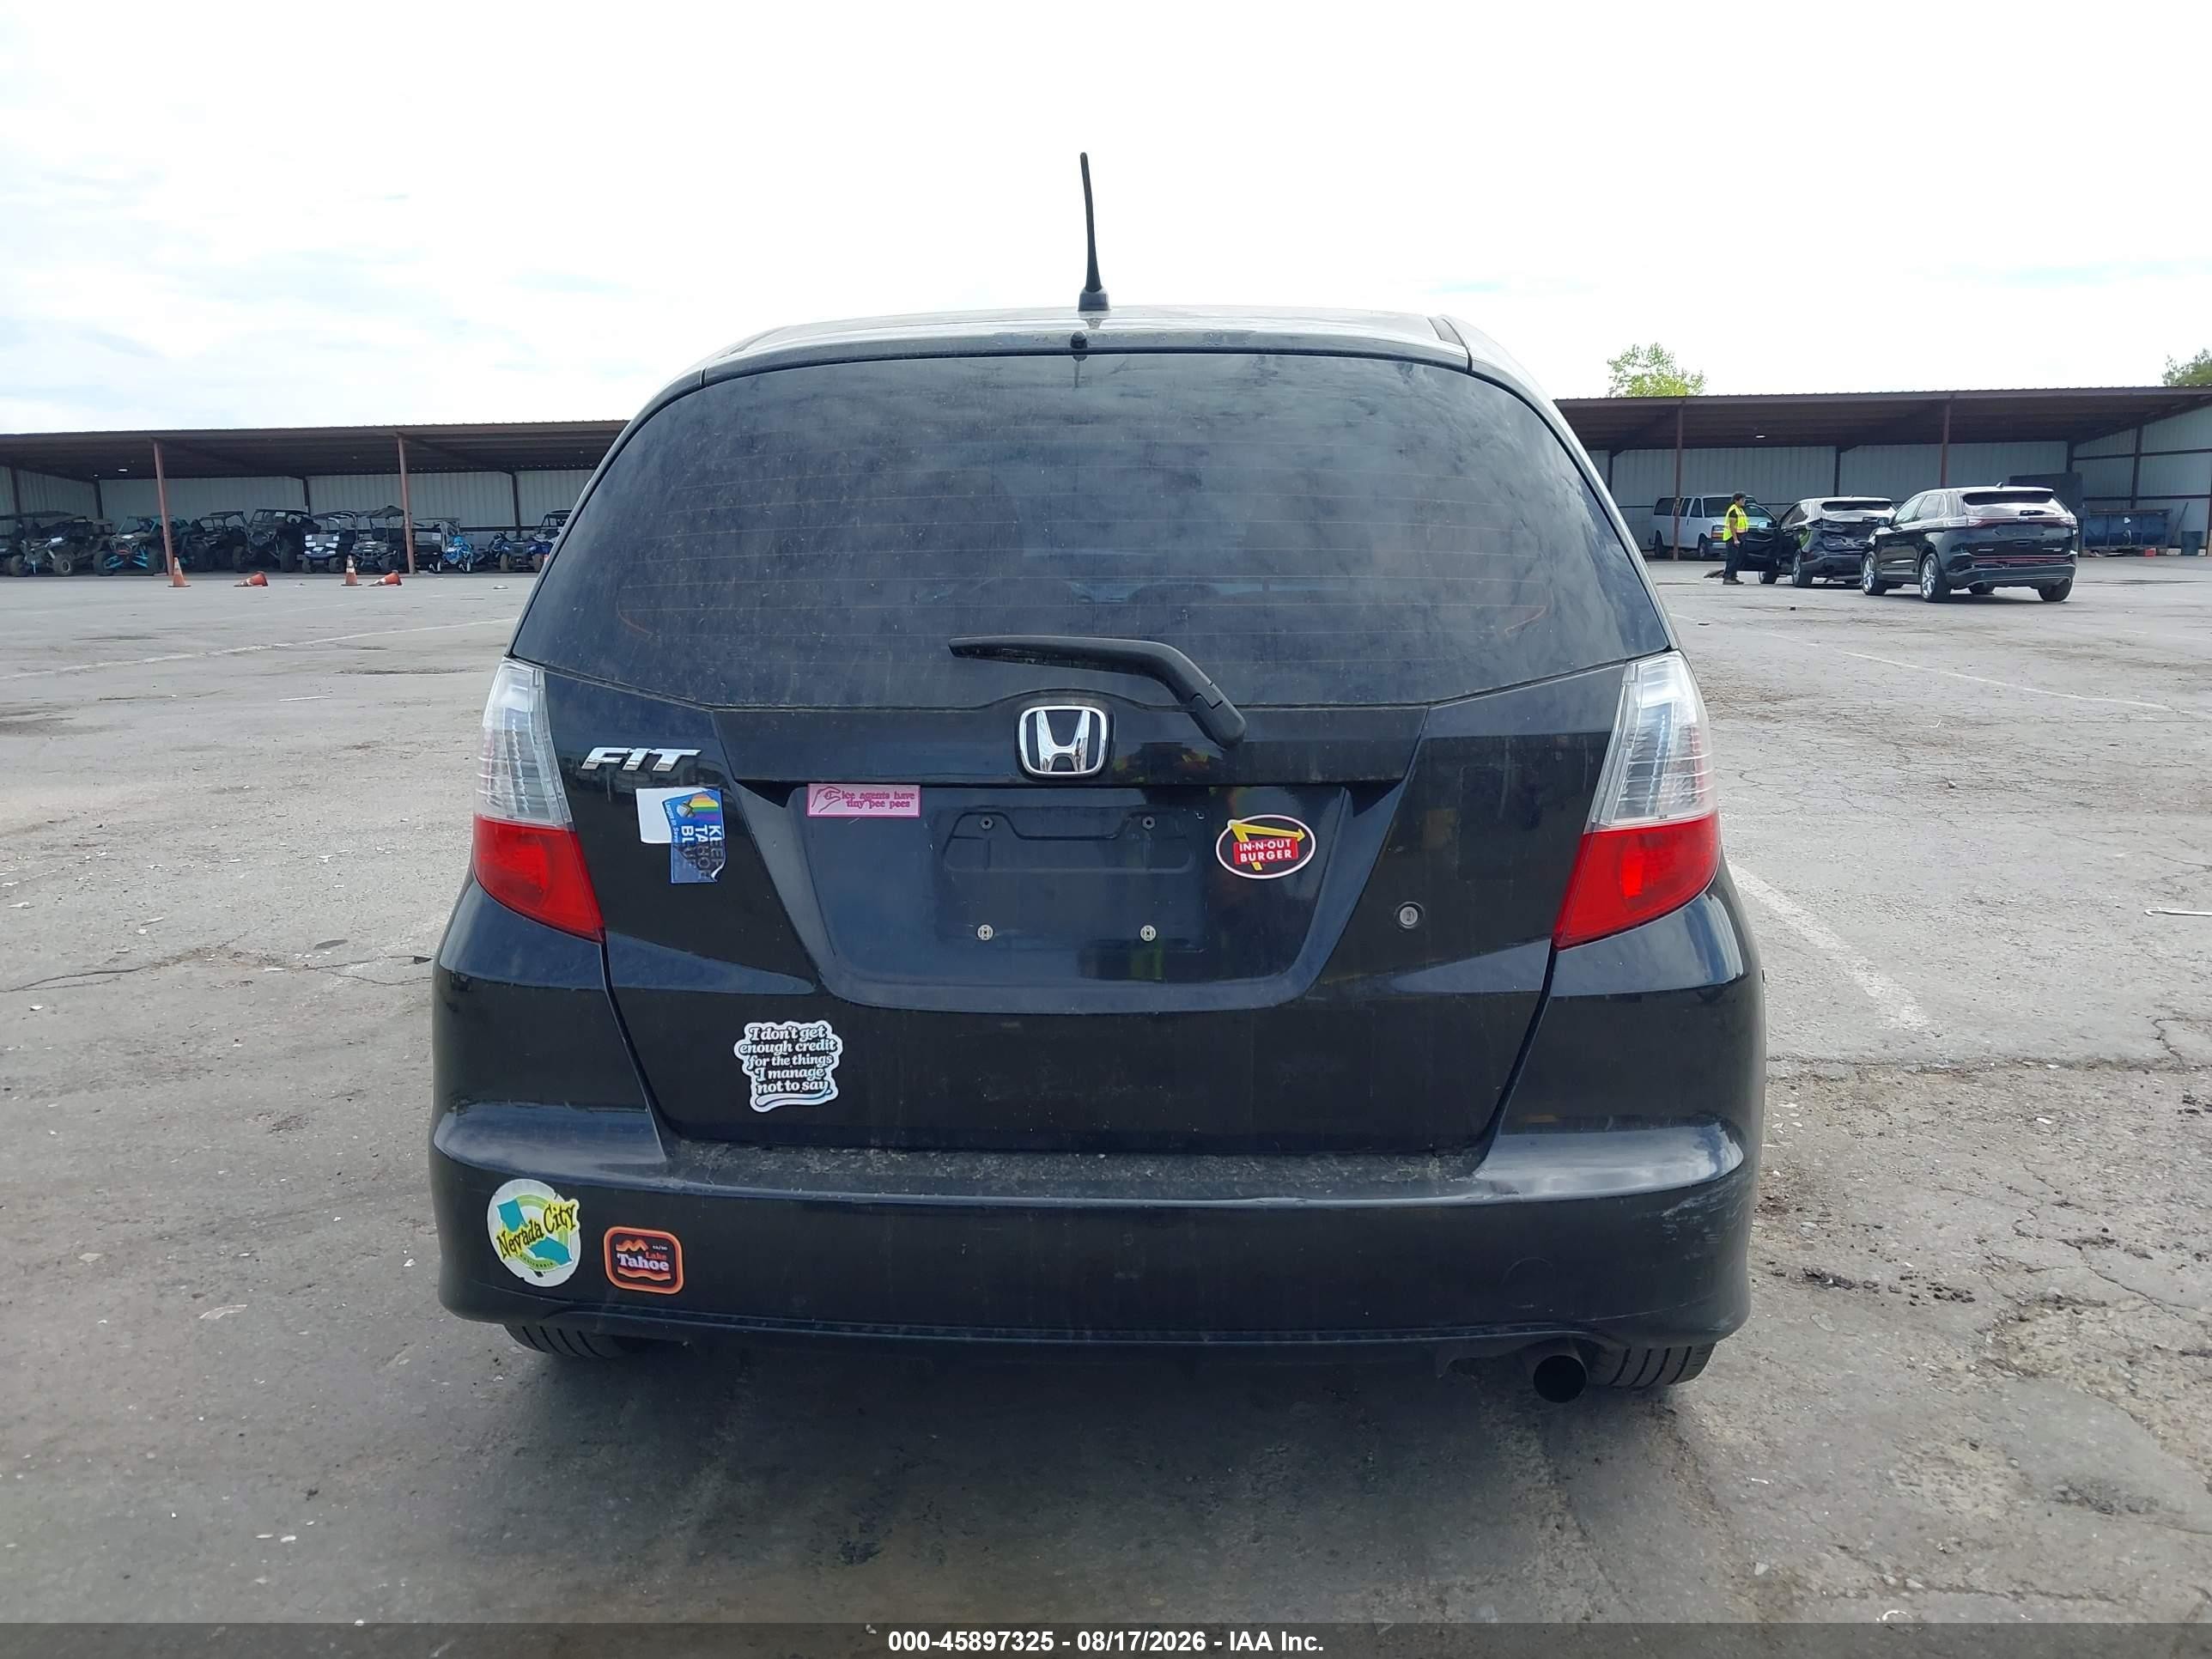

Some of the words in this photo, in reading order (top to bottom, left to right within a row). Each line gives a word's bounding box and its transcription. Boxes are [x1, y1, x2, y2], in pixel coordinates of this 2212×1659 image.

[580, 746, 702, 772] FIT
[860, 791, 890, 801] agents
[894, 791, 915, 799] have
[846, 799, 865, 809] tiny
[868, 799, 889, 809] pee
[890, 799, 910, 809] pees
[1240, 849, 1292, 863] BURGER
[750, 1027, 760, 1041] I
[760, 1026, 799, 1041] don't
[799, 1025, 826, 1042] get
[739, 1041, 793, 1055] enough
[795, 1039, 837, 1052] credit
[746, 1055, 769, 1070] for
[771, 1055, 791, 1066] the
[792, 1054, 833, 1067] things
[755, 1067, 766, 1081] I
[768, 1067, 825, 1081] manage
[757, 1080, 784, 1094] not
[785, 1080, 800, 1091] to
[496, 1218, 544, 1260] Nevada
[543, 1203, 577, 1234] City
[617, 1253, 670, 1271] Tahoe
[646, 1251, 667, 1261] Lake
